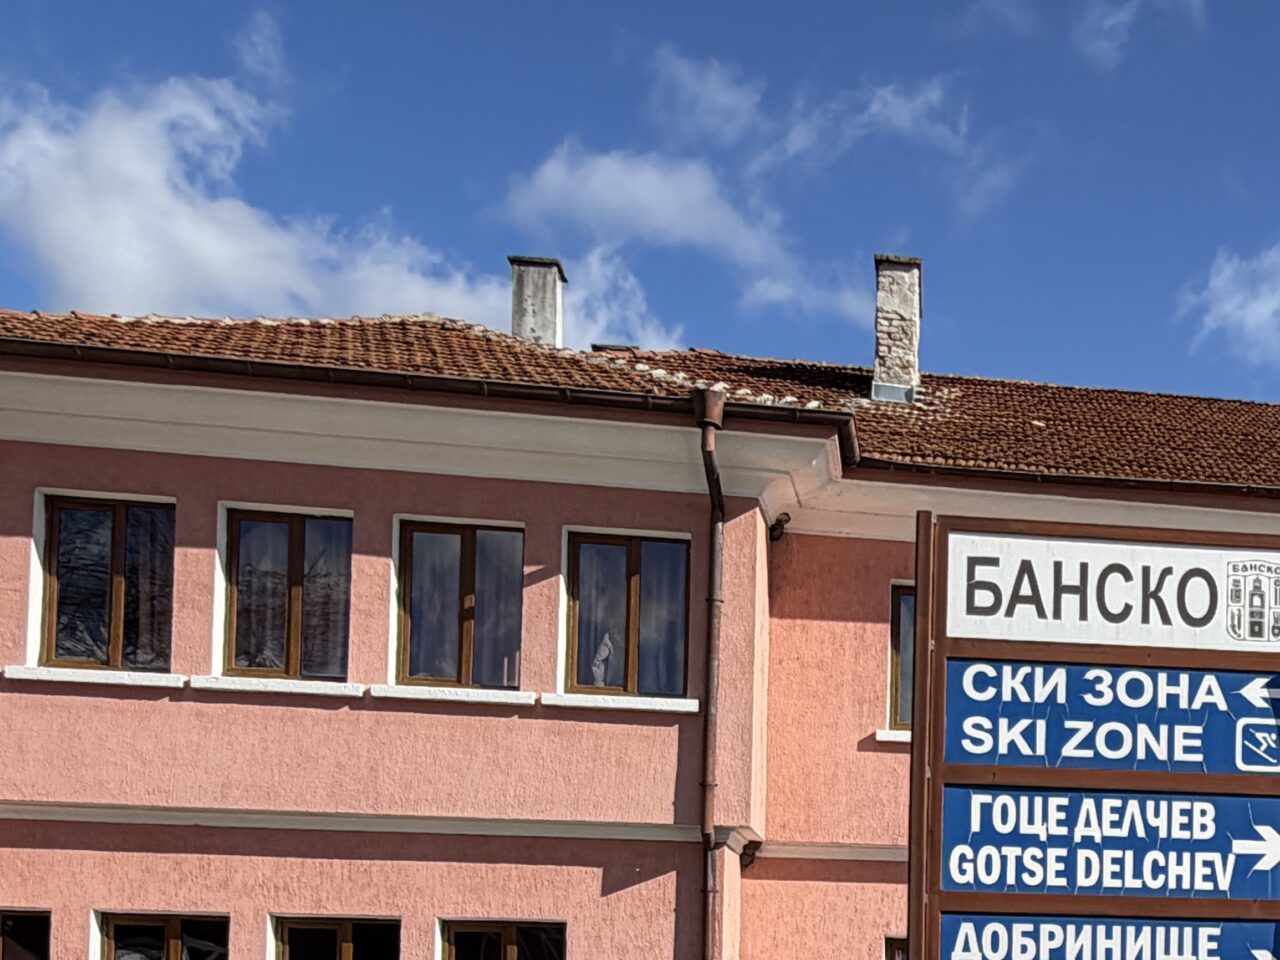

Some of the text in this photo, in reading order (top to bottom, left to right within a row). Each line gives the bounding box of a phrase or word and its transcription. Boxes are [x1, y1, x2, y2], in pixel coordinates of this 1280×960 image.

[966, 556, 1218, 628] БАНСКО
[962, 664, 1228, 711] СКИ ЗОНА
[961, 717, 1204, 762] SKI ZONE
[970, 794, 1216, 843] ГОЦЕ ДЕЛЧЕВ
[949, 844, 1236, 891] GOTSE DELCHEV
